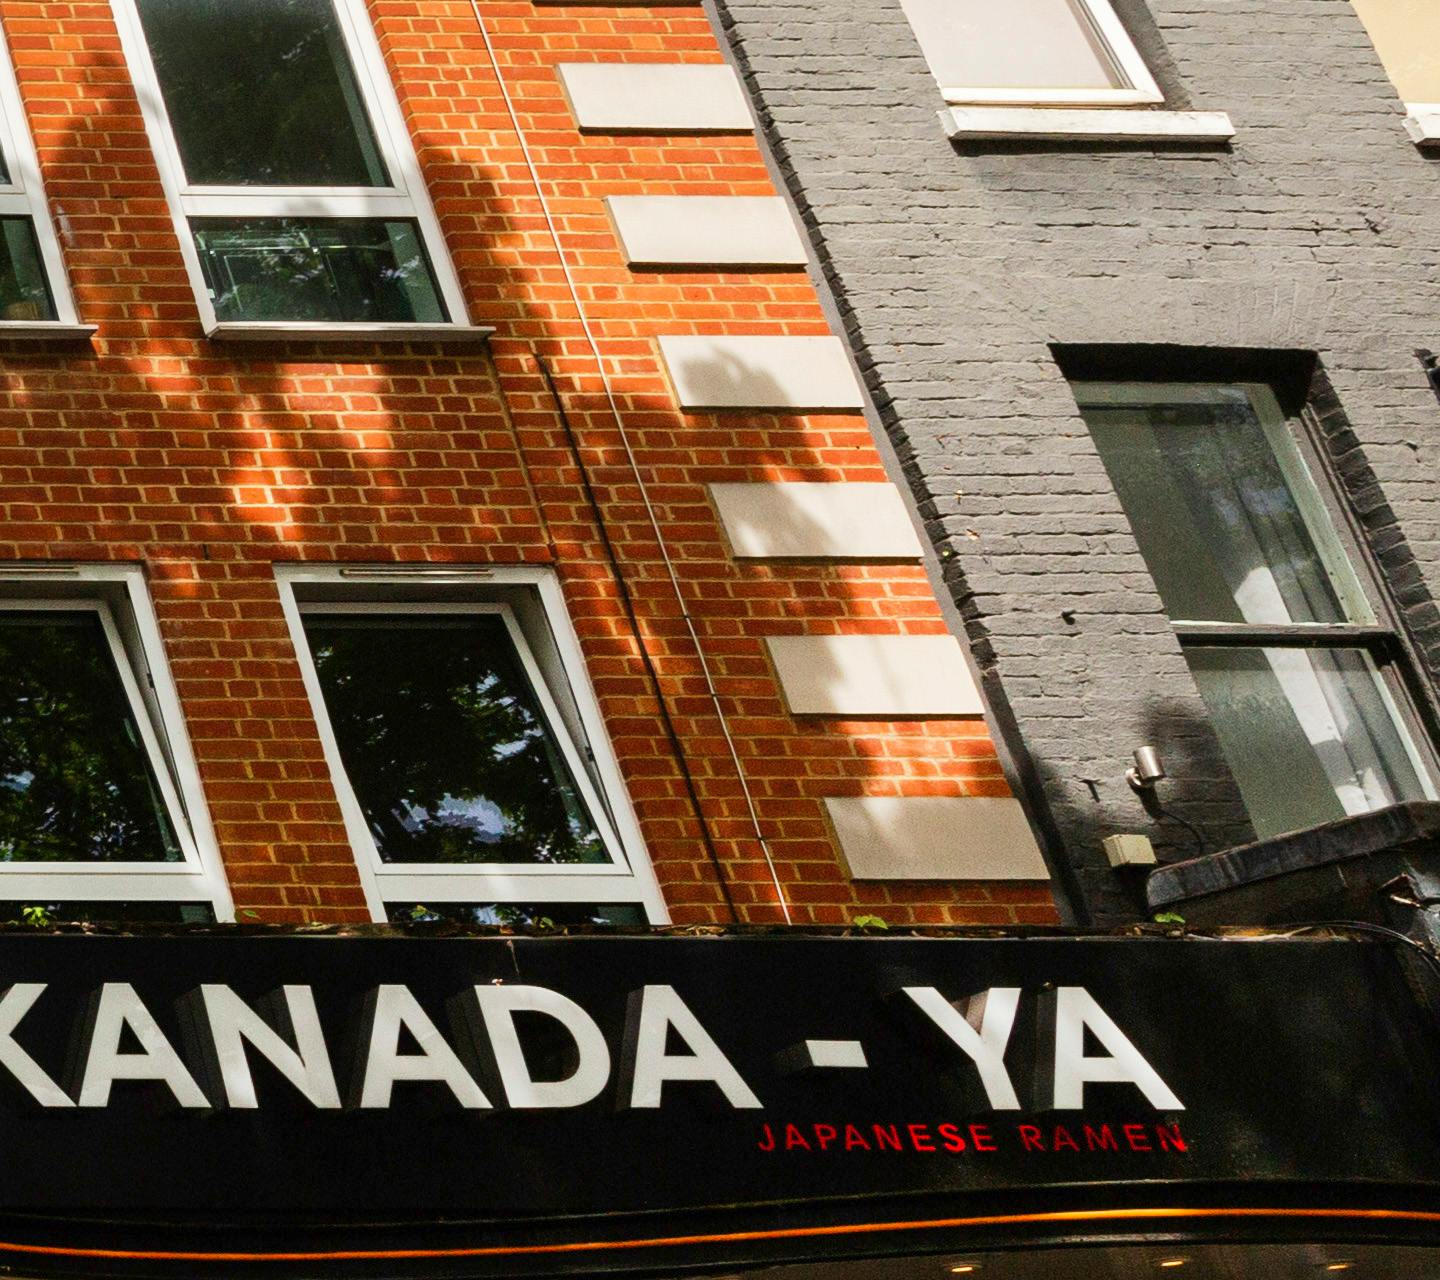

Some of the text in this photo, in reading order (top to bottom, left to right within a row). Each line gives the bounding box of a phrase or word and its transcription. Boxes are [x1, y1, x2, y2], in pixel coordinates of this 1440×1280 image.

[899, 985, 1186, 1111] YA
[757, 1123, 1187, 1153] JAPANESE RAMEN
